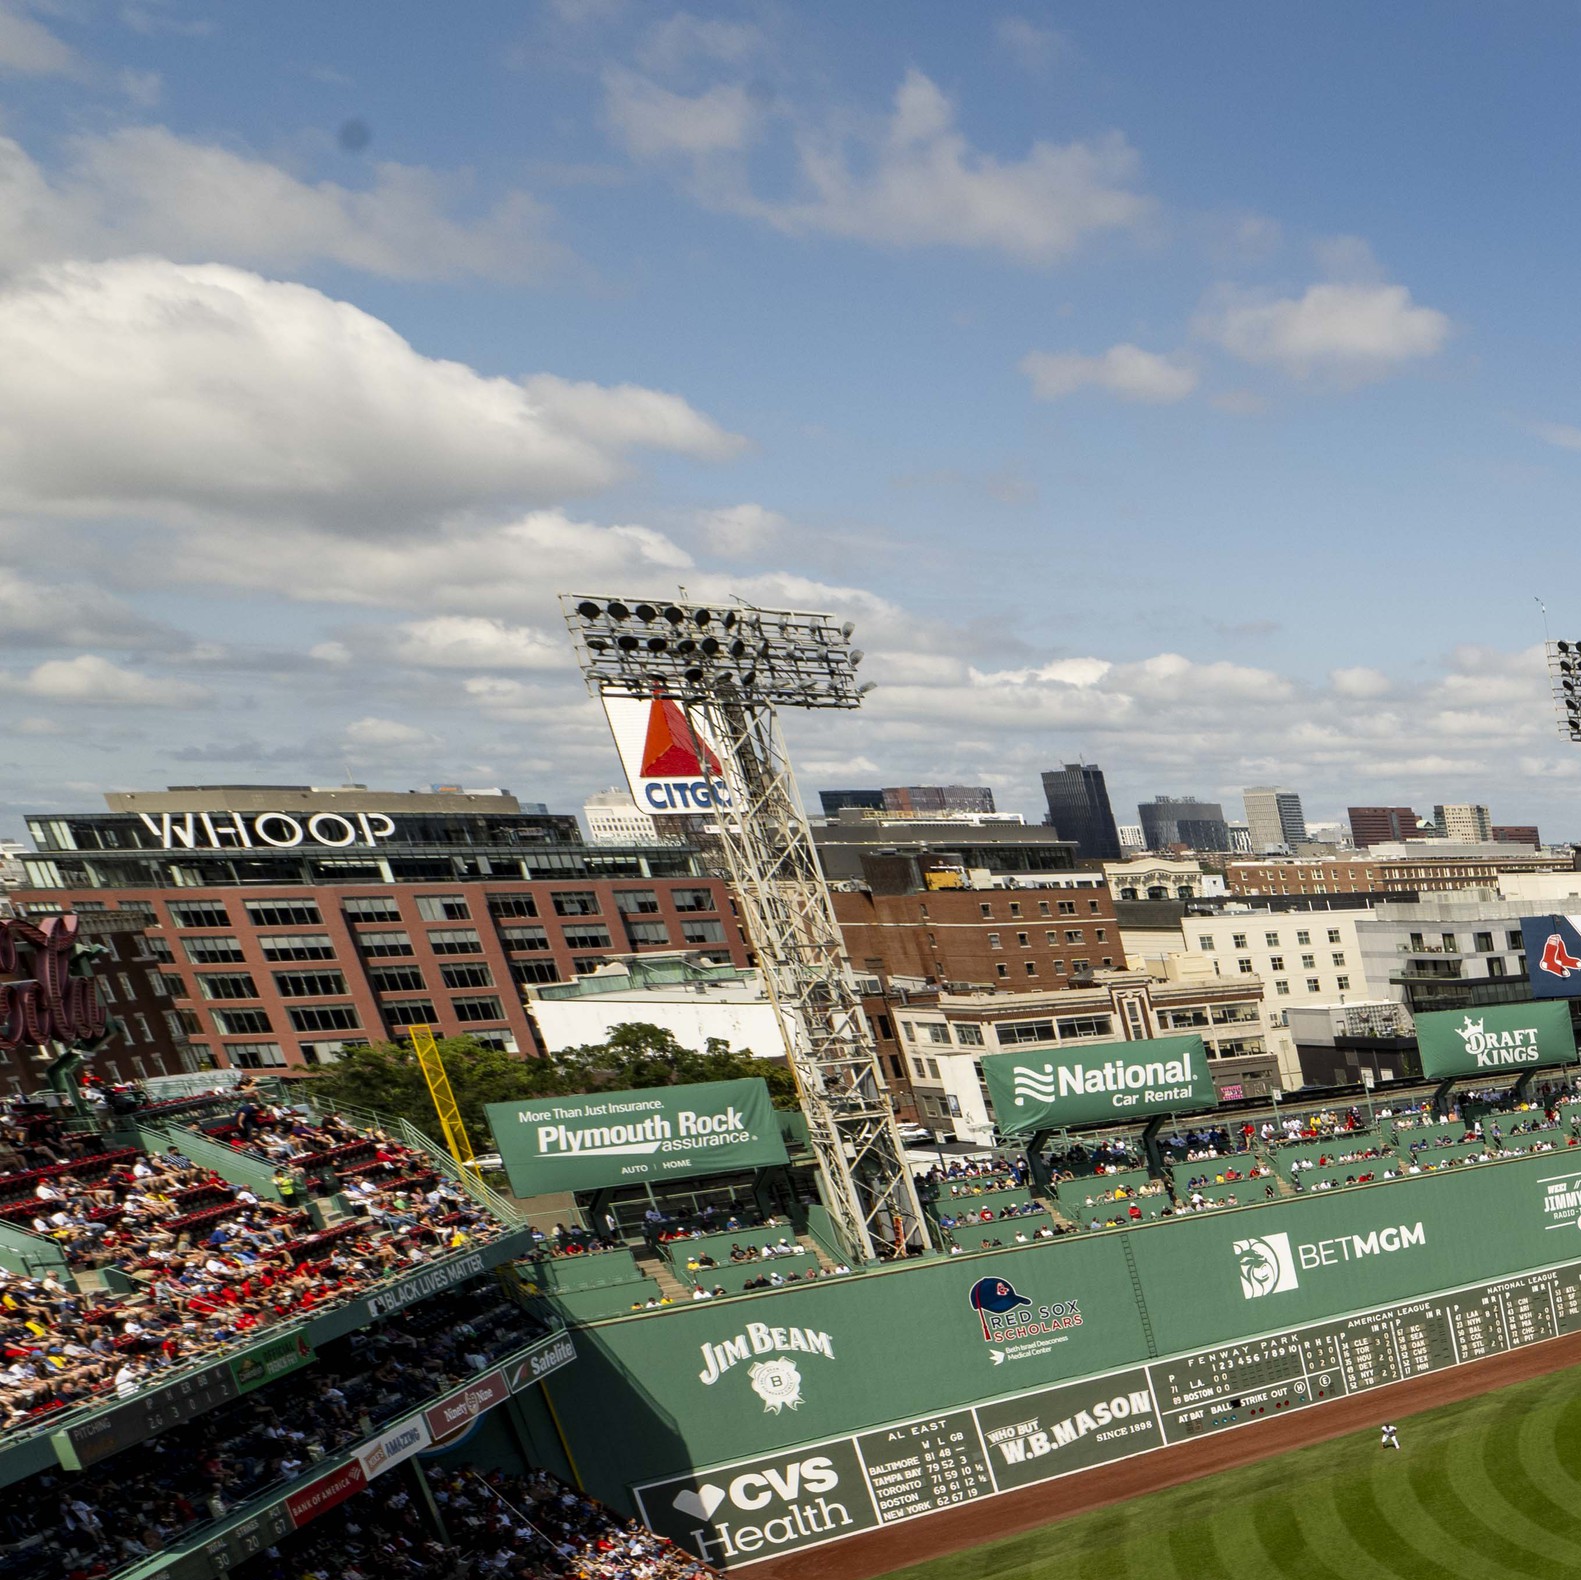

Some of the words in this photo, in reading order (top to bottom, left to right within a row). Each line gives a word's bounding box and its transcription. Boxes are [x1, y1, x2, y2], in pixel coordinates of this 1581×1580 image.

[138, 812, 396, 850] WHOOP
[1465, 1028, 1538, 1054] DRAFT
[1477, 1045, 1539, 1067] KINGS
[1057, 1053, 1192, 1097] National
[1112, 1093, 1139, 1107] Car
[1144, 1085, 1192, 1103] Rental
[519, 1111, 550, 1123] More
[552, 1107, 583, 1120] Than
[584, 1104, 607, 1117] Just
[609, 1100, 664, 1114] Insurance.
[538, 1114, 671, 1153] Plymouth
[678, 1106, 743, 1136] Rock
[662, 1130, 750, 1153] assurance
[621, 1164, 648, 1175] AUTO
[662, 1158, 692, 1170] HOME
[1298, 1221, 1426, 1270] BETMGM
[385, 1279, 420, 1309] BLACK
[420, 1268, 449, 1296] LIVES
[449, 1254, 485, 1285] MATTER
[1487, 1279, 1525, 1294] NATIONAL
[1528, 1272, 1557, 1284] LEAGUE
[990, 1311, 1032, 1330] RED
[1039, 1300, 1080, 1320] SOX
[993, 1314, 1083, 1343] SCHOLARS
[1348, 1311, 1394, 1328] AMERICAN
[1397, 1302, 1431, 1316] LEAGUE
[699, 1335, 752, 1385] JIM
[745, 1322, 835, 1360] BEAM
[1031, 1346, 1052, 1355] Center
[1188, 1345, 1249, 1367] FENWAY
[1260, 1334, 1299, 1350] PARK
[1353, 1338, 1369, 1347] CLE
[530, 1340, 573, 1376] Safelite
[770, 1376, 782, 1387] B
[1183, 1388, 1214, 1402] BOSTON
[1190, 1410, 1204, 1421] BAT
[1210, 1402, 1232, 1415] BALL
[1240, 1393, 1268, 1407] STRIKE
[1270, 1388, 1288, 1398] OUT
[385, 1427, 421, 1458] AMAZING
[888, 1431, 905, 1441] AL
[911, 1420, 947, 1435] EAST
[950, 1432, 964, 1442] GB
[987, 1427, 1015, 1444] WHO
[1017, 1420, 1040, 1437] BUT
[1096, 1427, 1128, 1442] SINCE
[1130, 1420, 1152, 1433] 1898
[869, 1456, 920, 1476] BALTIMORE
[939, 1448, 951, 1457] 48
[872, 1472, 903, 1487] TAMPA
[905, 1468, 922, 1479] BAY
[926, 1463, 940, 1473] 79
[941, 1459, 954, 1469] 52
[292, 1502, 312, 1517] BANK
[320, 1478, 351, 1503] AMERICA
[729, 1456, 839, 1511] CVS
[876, 1480, 922, 1498] TORONTO
[944, 1470, 958, 1480] 59
[880, 1492, 919, 1510] BOSTON
[933, 1485, 947, 1495] 69
[950, 1481, 960, 1491] 61
[964, 1477, 975, 1487] 12
[883, 1508, 904, 1521] NEW
[906, 1501, 932, 1514] YORK
[937, 1496, 950, 1506] 62
[952, 1492, 964, 1502] 67
[968, 1488, 978, 1498] 19
[690, 1497, 854, 1563] Health
